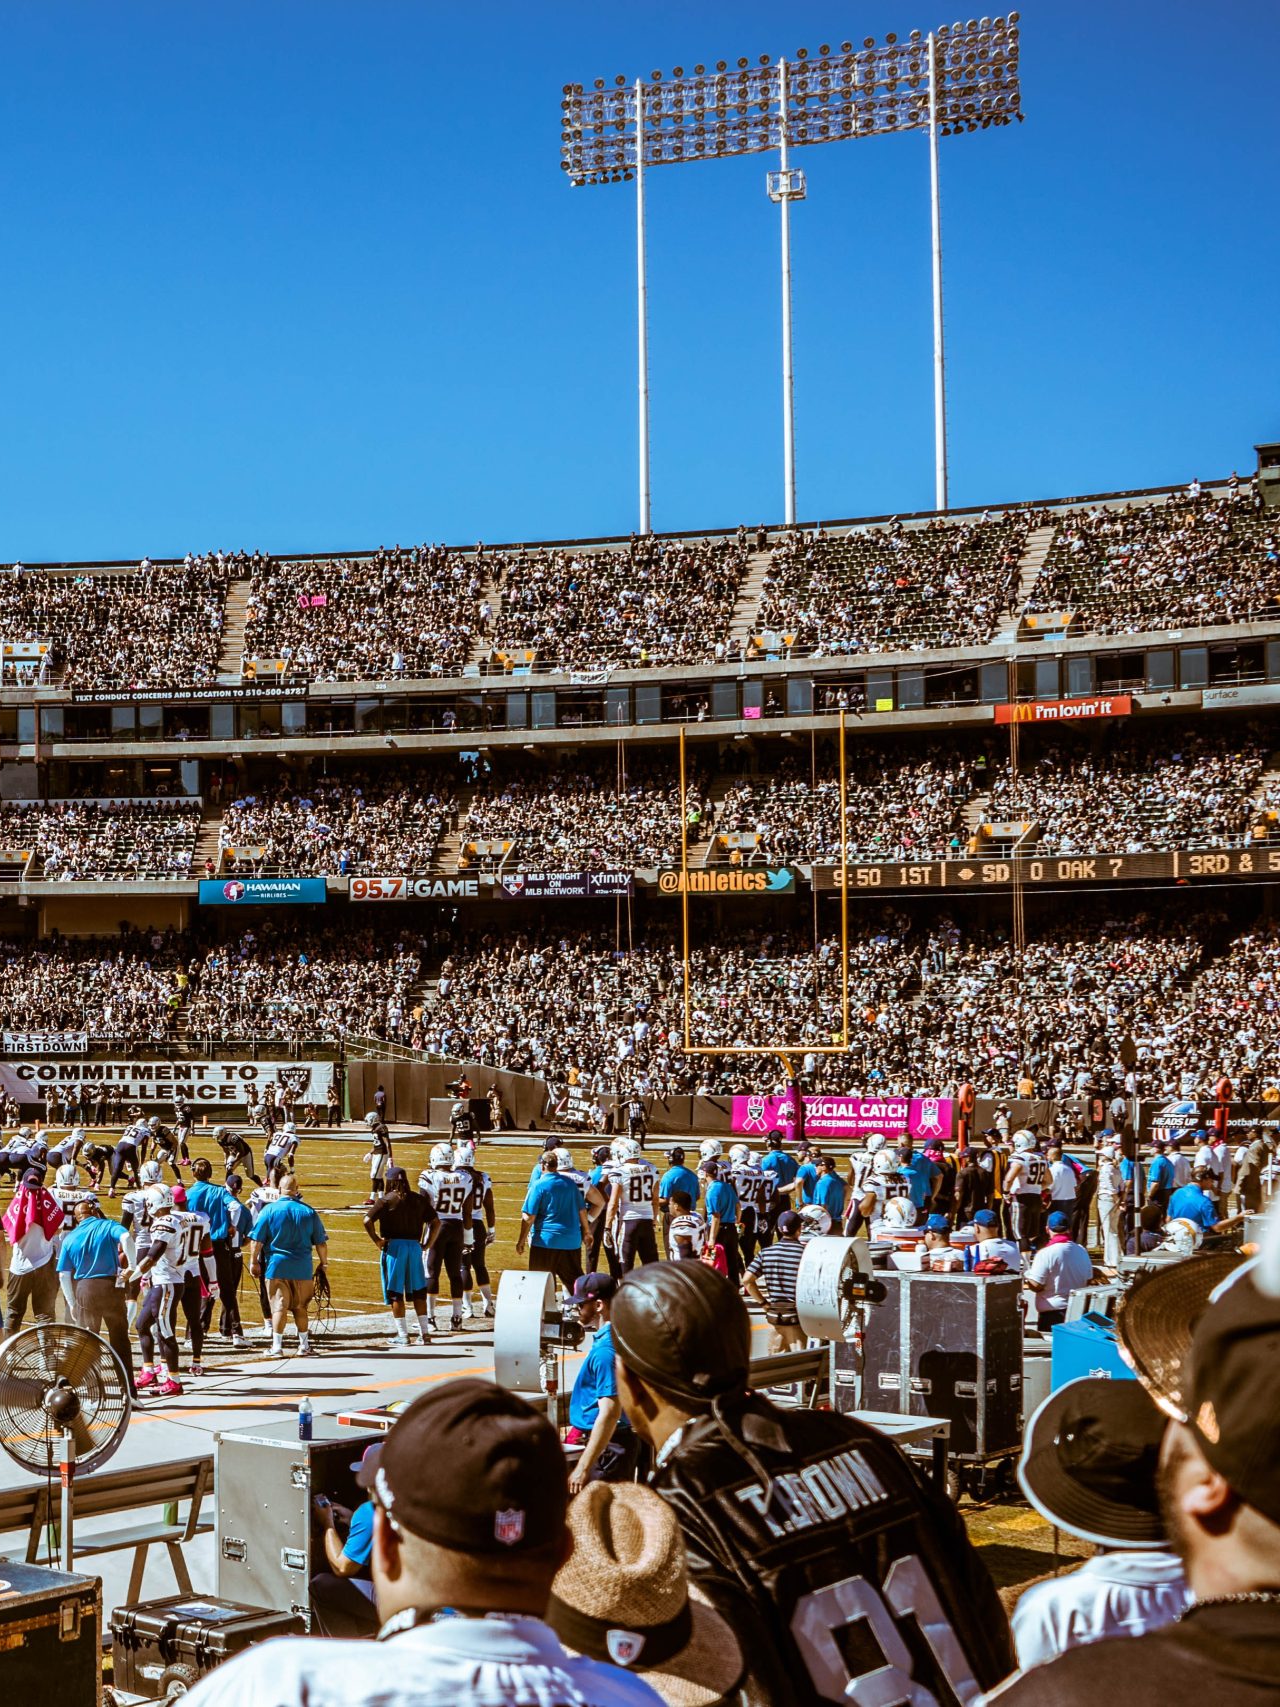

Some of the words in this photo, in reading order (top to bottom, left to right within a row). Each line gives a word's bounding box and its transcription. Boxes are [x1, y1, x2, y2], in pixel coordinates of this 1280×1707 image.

[95, 693, 131, 701] CONDUCT
[132, 691, 172, 700] CONCERNS
[174, 691, 190, 699] AND
[193, 689, 231, 698] LOCATION
[232, 689, 244, 697] TO
[245, 687, 307, 696] 510-500-8787
[1202, 688, 1239, 700] Surface
[1035, 704, 1057, 719] i'm
[1058, 700, 1099, 718] lovin'
[1099, 701, 1112, 715] it
[981, 864, 1010, 883] SD
[1057, 860, 1096, 880] OAK
[1108, 858, 1123, 878] 7
[1189, 854, 1230, 875] 3RD
[1238, 853, 1253, 872] &
[527, 873, 545, 881] MLB
[546, 873, 582, 881] TONIGHT
[590, 872, 632, 886] xfinity
[659, 871, 767, 893] @Athletics
[832, 868, 881, 887] 9:50
[899, 866, 933, 886] 1ST
[246, 883, 301, 892] HAWAIIAN
[352, 879, 404, 899] 95.7
[414, 879, 479, 897] GAME
[525, 888, 543, 896] MLB
[544, 887, 585, 895] NETWORK
[16, 1064, 210, 1081] COMMITMENT
[224, 1064, 259, 1081] TO
[859, 1103, 908, 1118] CATCH
[811, 1118, 856, 1128] SCREENING
[858, 1119, 883, 1128] SAVES
[884, 1119, 908, 1128] LIVES
[1152, 1117, 1183, 1126] HEADS
[1184, 1117, 1199, 1126] UP
[629, 1174, 654, 1203] 83
[437, 1187, 466, 1214] 69
